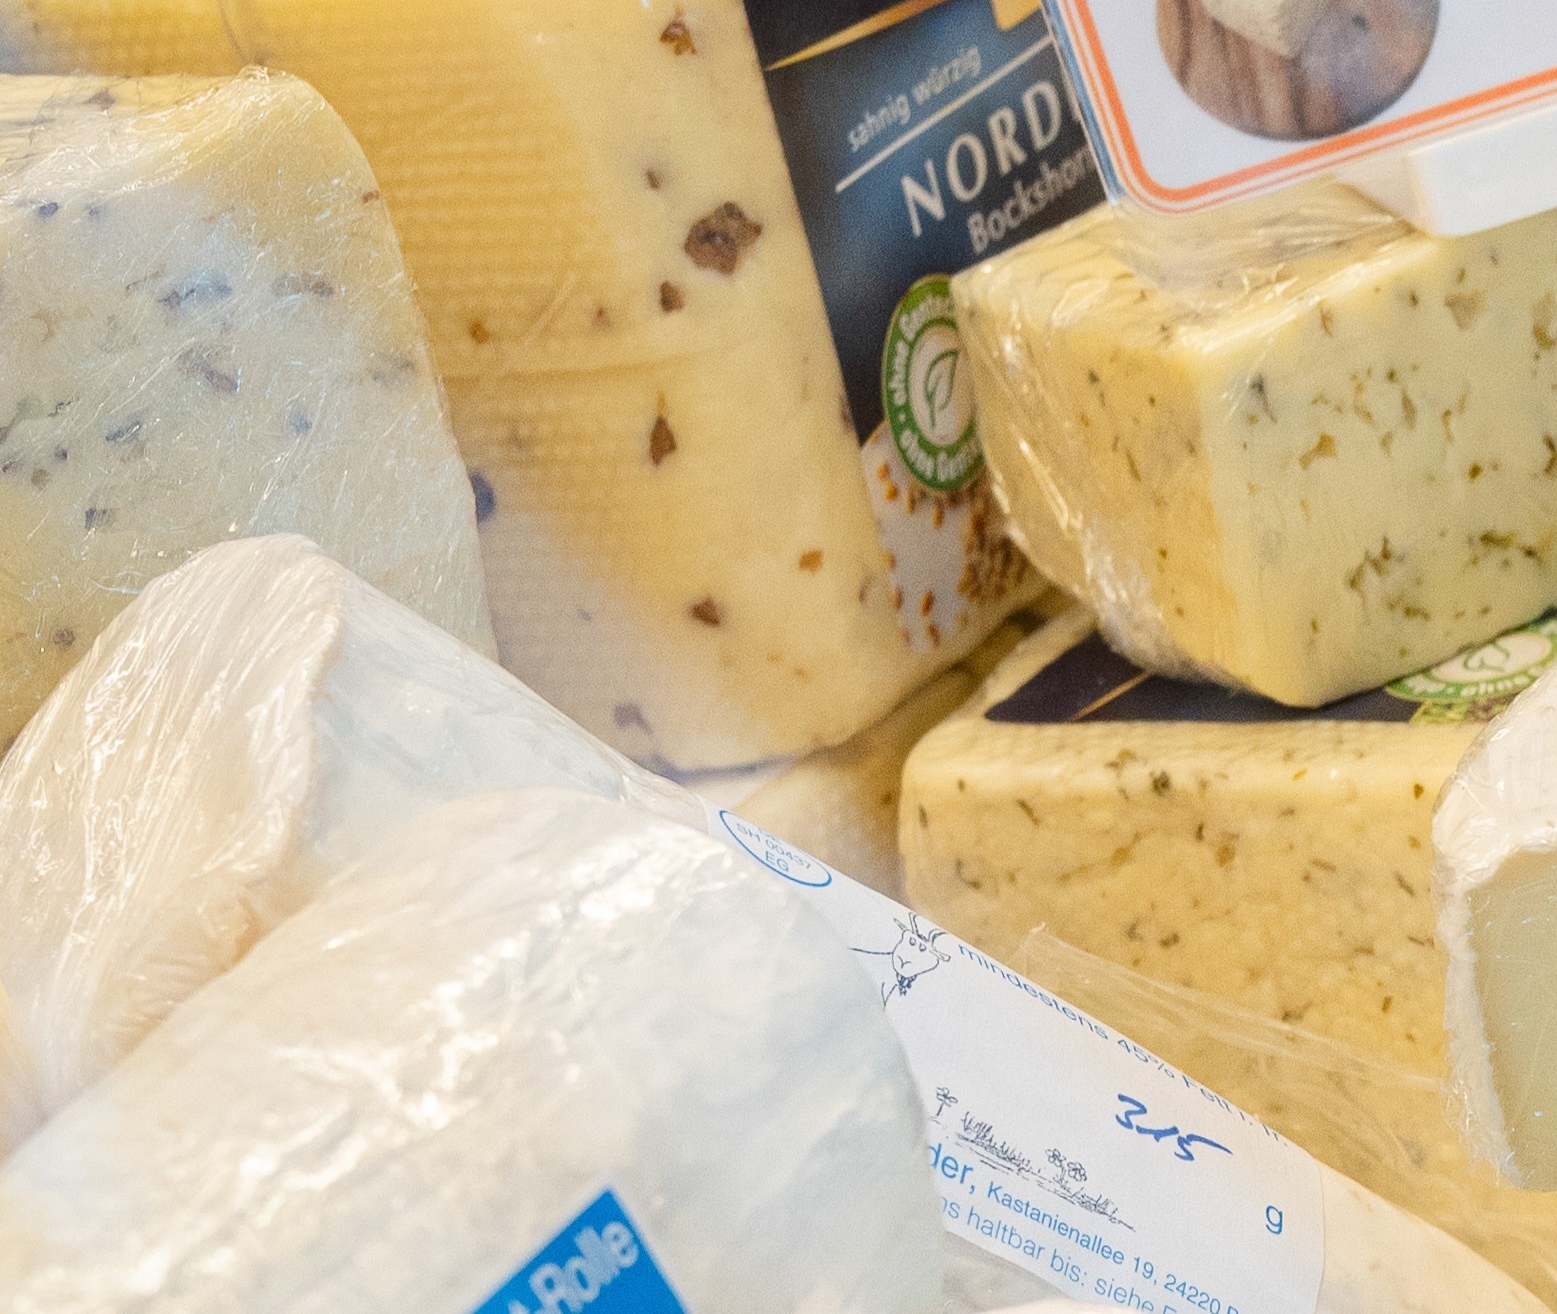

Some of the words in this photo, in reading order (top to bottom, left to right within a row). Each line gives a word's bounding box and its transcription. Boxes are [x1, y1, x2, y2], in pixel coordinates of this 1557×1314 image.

[850, 93, 912, 153] sahnig
[912, 45, 983, 105] würzig
[956, 942, 1109, 1040] mindestens
[965, 1204, 1046, 1261] haltbar
[1050, 1248, 1089, 1288] bis:
[986, 1180, 1126, 1266] Kastanienallee
[1132, 1256, 1159, 1287] 19,
[1162, 1272, 1222, 1314] 24220
[1265, 1205, 1284, 1235] g
